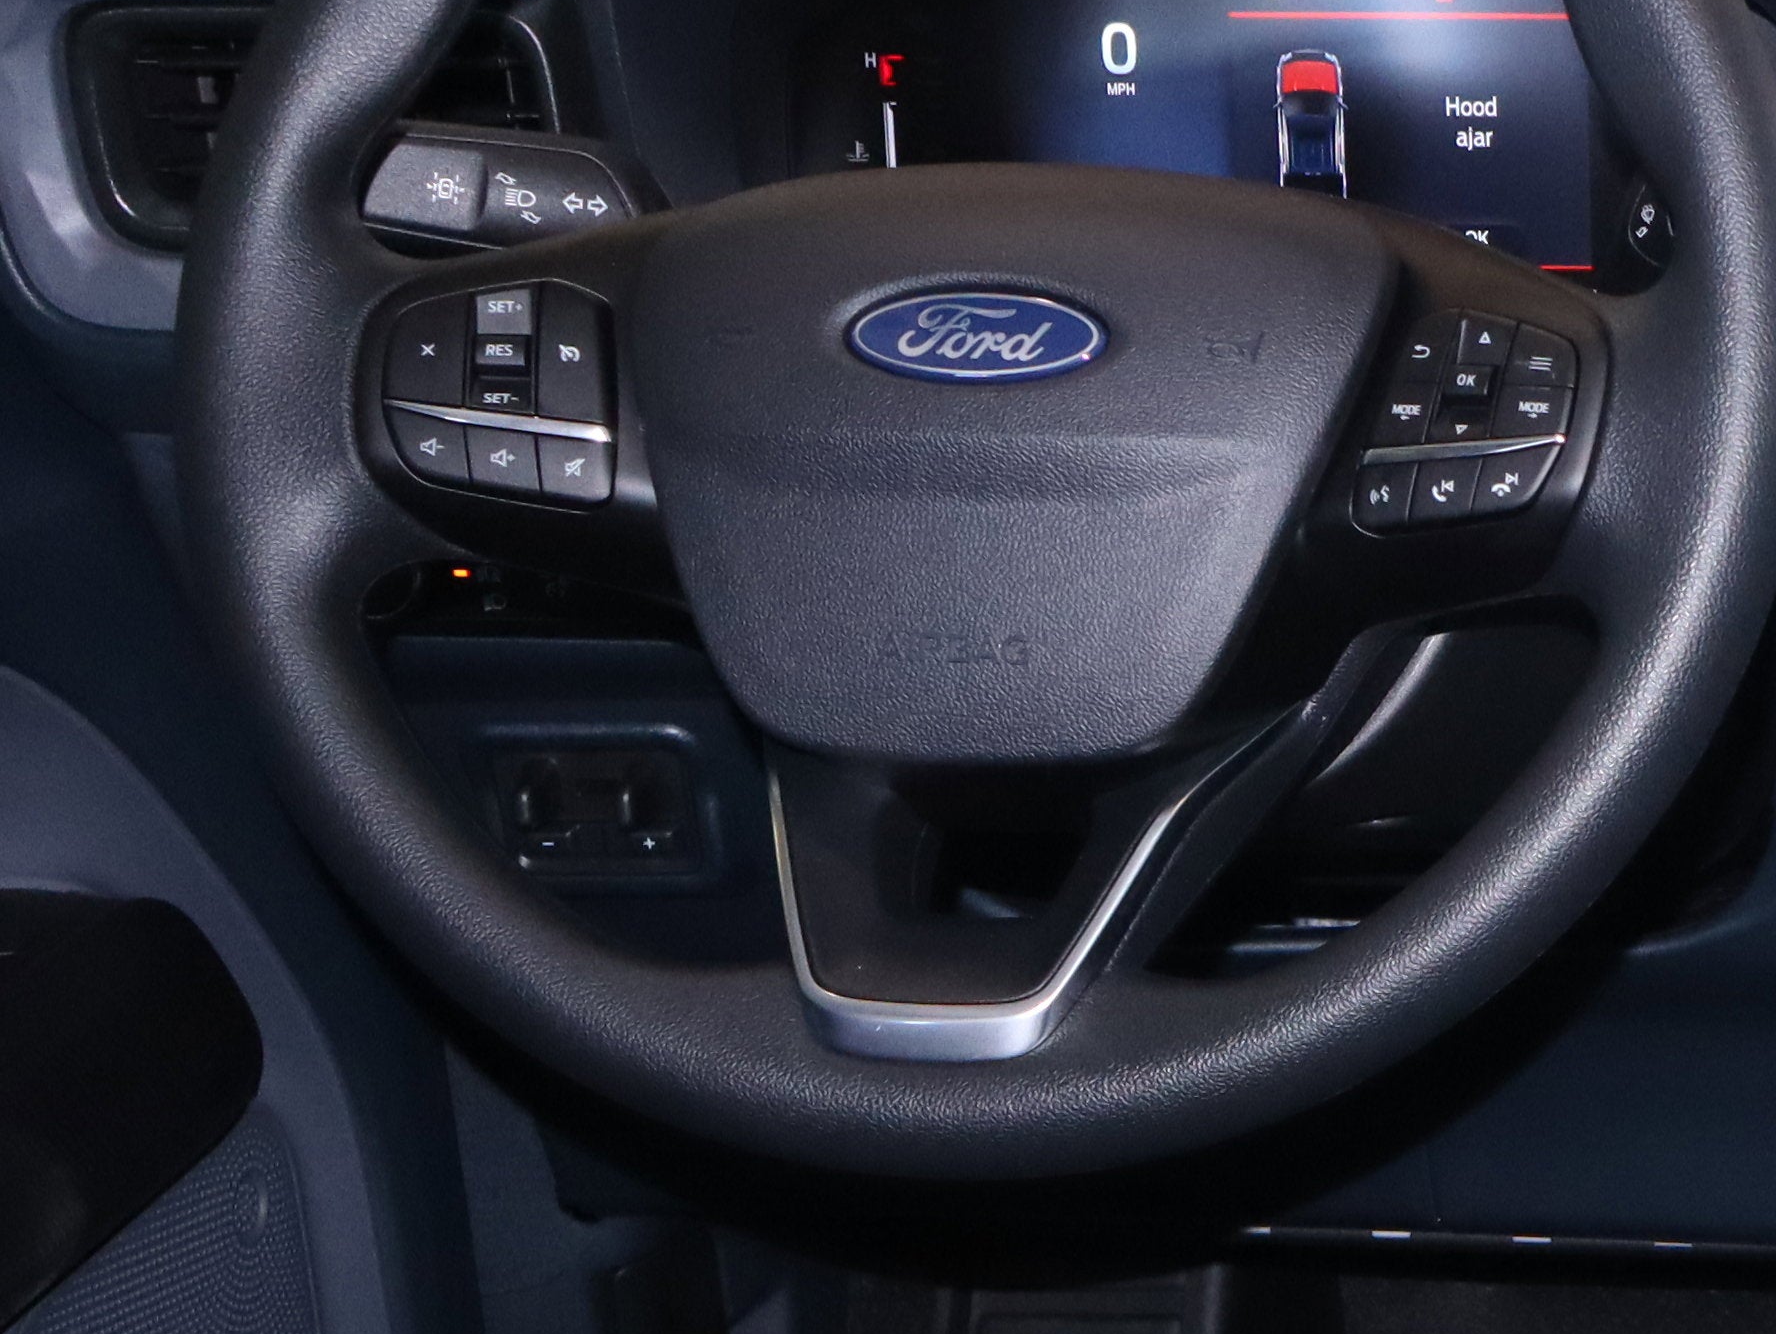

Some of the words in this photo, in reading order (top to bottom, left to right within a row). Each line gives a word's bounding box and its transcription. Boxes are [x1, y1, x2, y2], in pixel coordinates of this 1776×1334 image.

[1101, 21, 1138, 75] 0
[864, 52, 877, 69] H
[1106, 82, 1136, 96] MPH
[1445, 96, 1498, 118] Hood
[1455, 127, 1494, 151] ajar
[896, 303, 1055, 364] Ford
[485, 343, 513, 357] RES
[1456, 373, 1477, 387] OK
[1391, 403, 1422, 415] MODE
[1518, 401, 1549, 414] MODE
